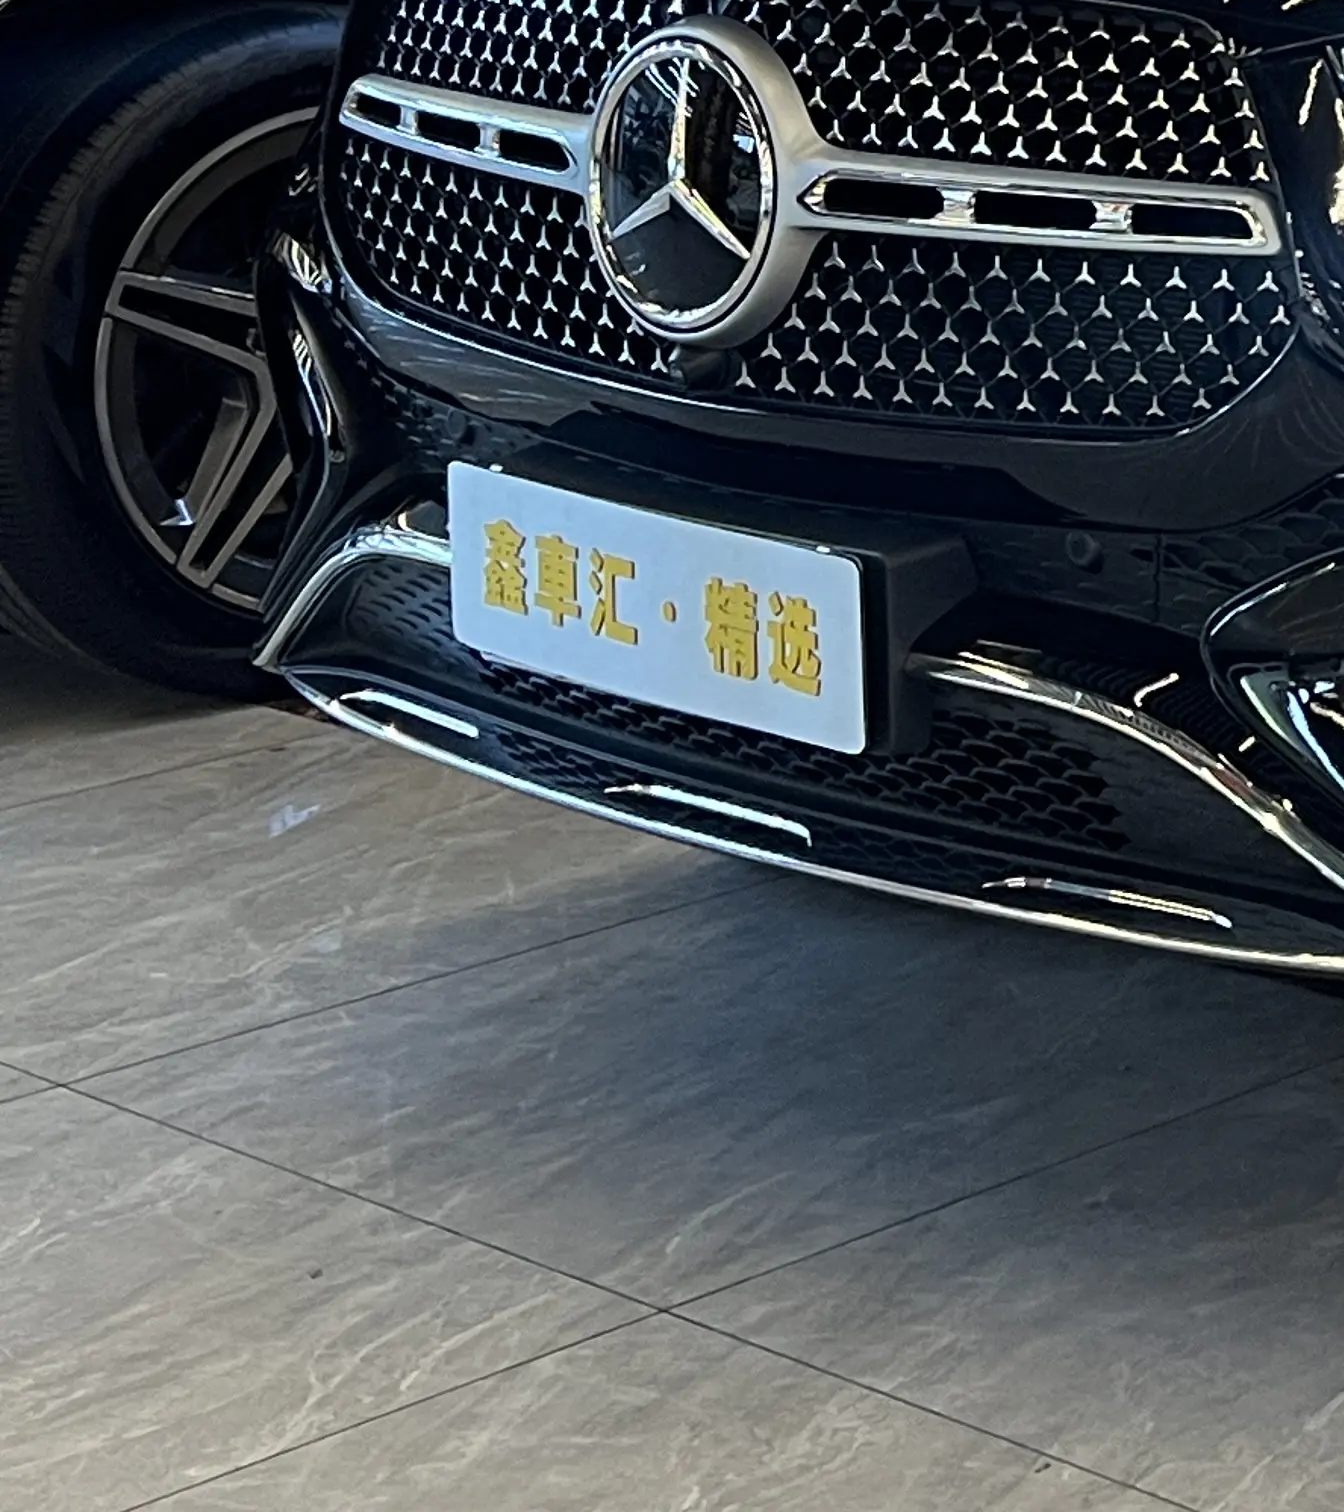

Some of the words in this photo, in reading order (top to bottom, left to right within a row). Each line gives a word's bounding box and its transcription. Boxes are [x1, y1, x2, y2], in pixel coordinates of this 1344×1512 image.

[482, 519, 823, 697] 鑫車汇·精选
